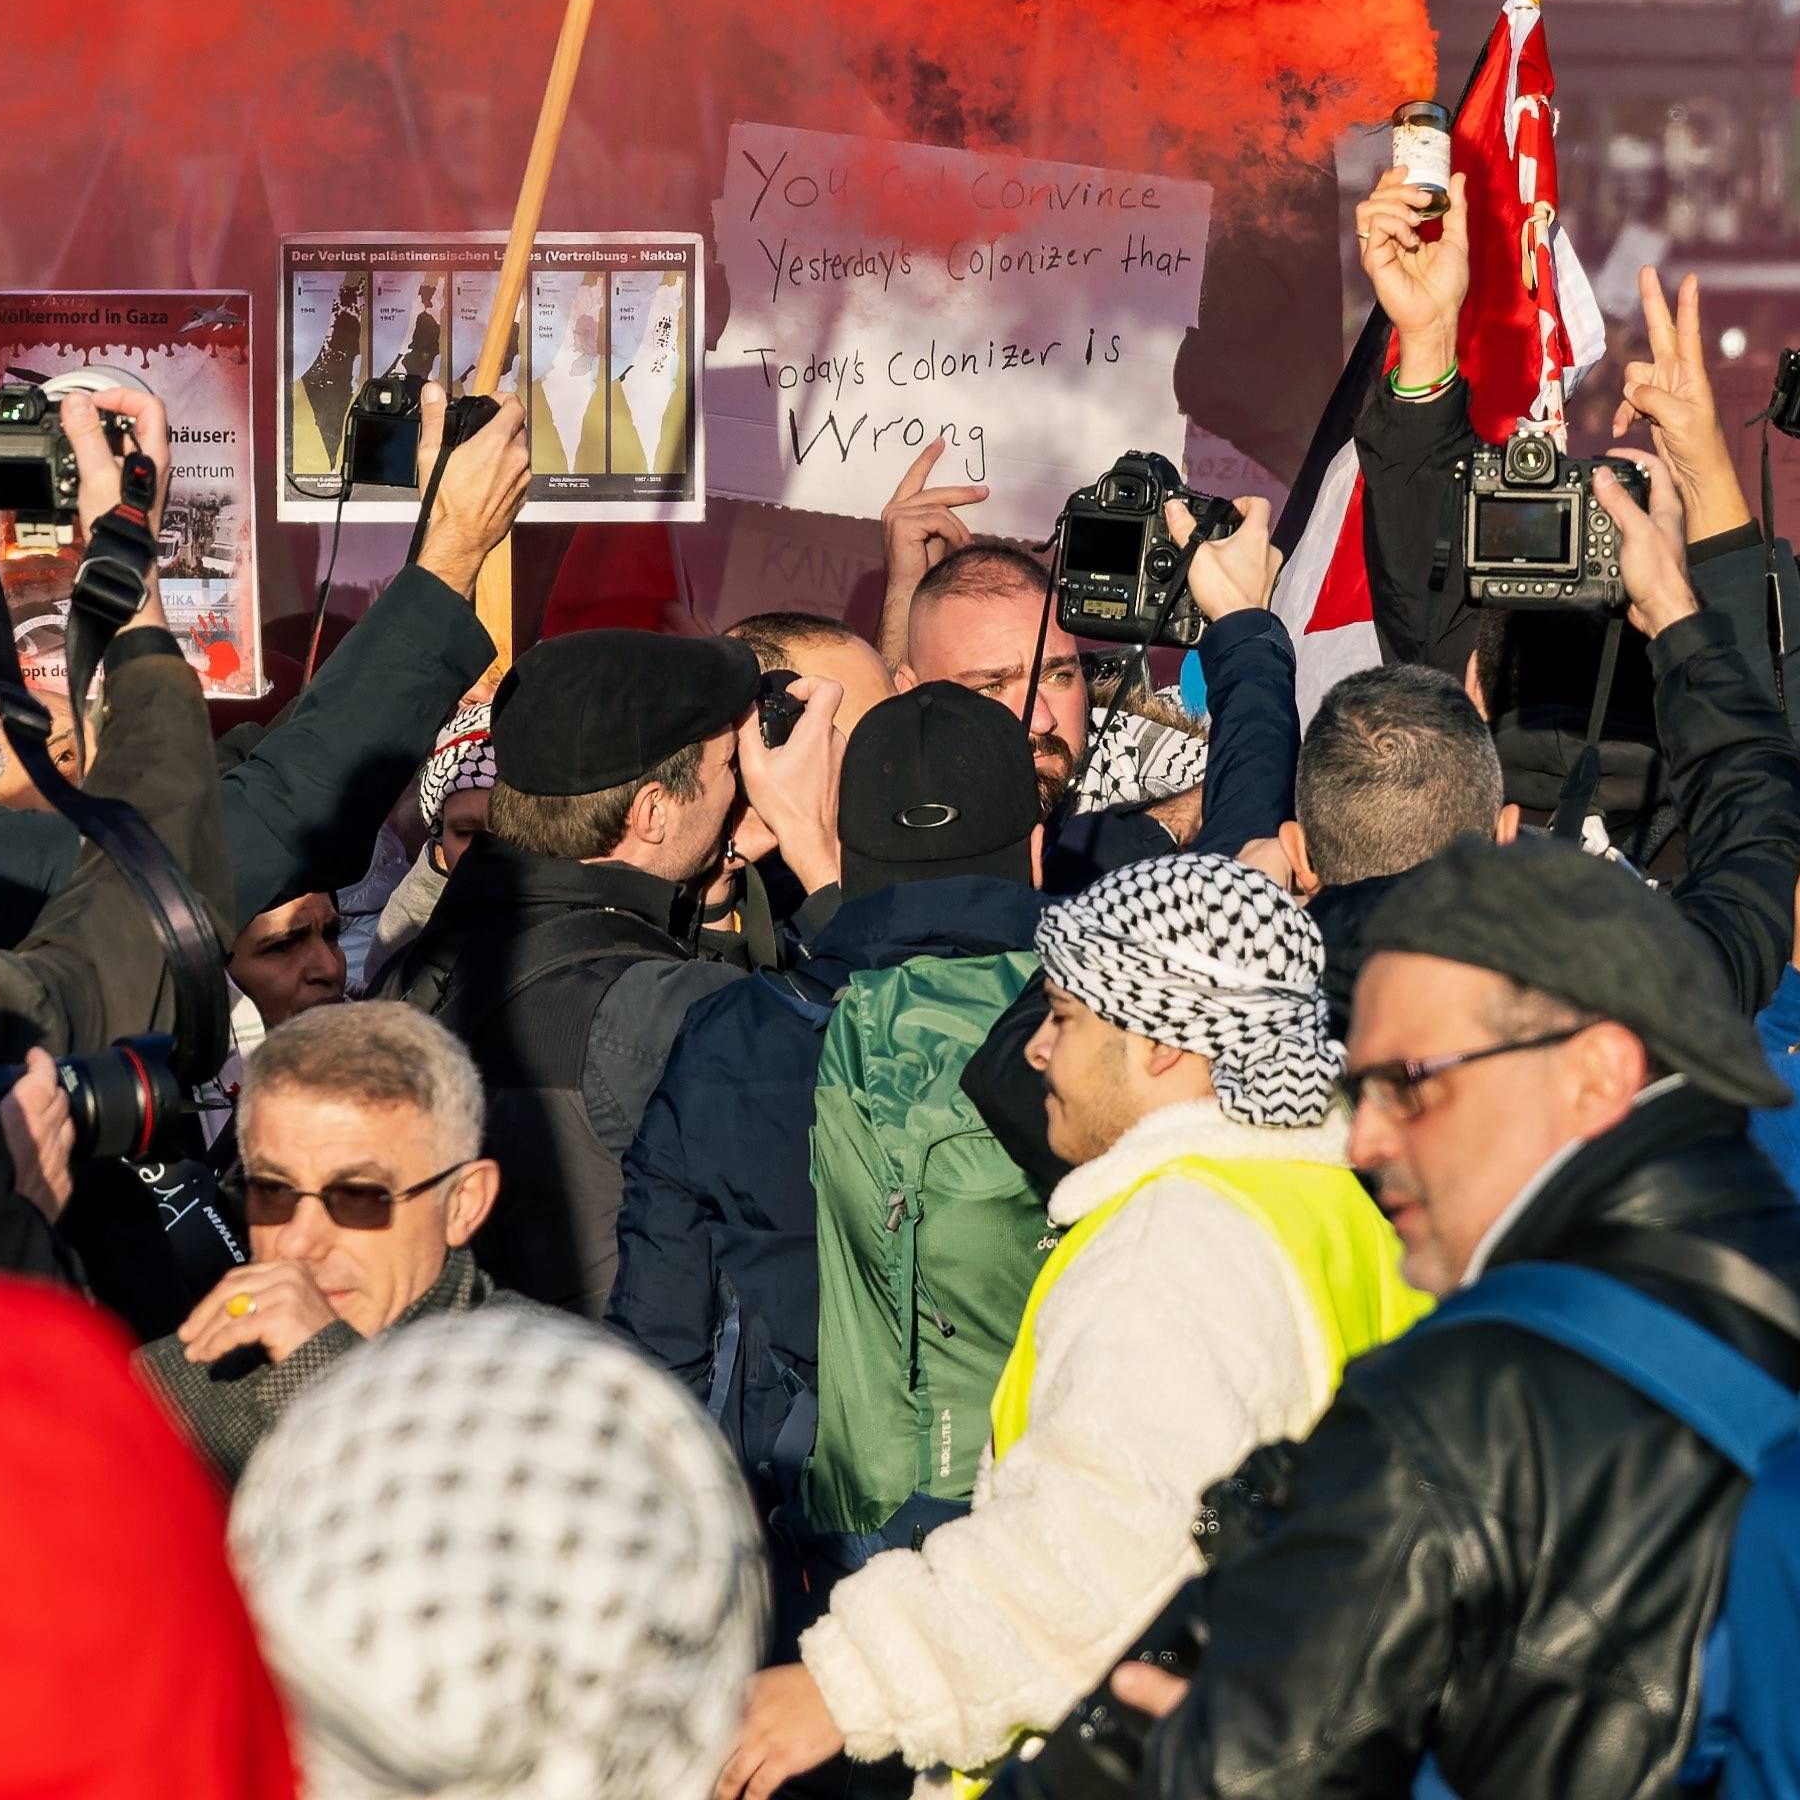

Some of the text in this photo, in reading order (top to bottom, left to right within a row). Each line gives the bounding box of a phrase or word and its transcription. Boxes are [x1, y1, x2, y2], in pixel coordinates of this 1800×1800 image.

[743, 150, 848, 221] You
[291, 250, 315, 262] Der
[318, 250, 367, 262] Verlust
[369, 250, 490, 264] palästinensischen
[544, 250, 629, 264] (Vertreibung
[640, 250, 687, 264] Nakba)
[758, 237, 912, 303] Yesterday's
[1120, 233, 1192, 277] that
[105, 308, 121, 325] in
[126, 309, 169, 325] Gaza
[743, 348, 865, 400] Today's
[168, 425, 236, 443] häuser:
[788, 408, 987, 482] Wrong
[168, 464, 235, 478] zentrum
[203, 1205, 247, 1263] BTWIN
